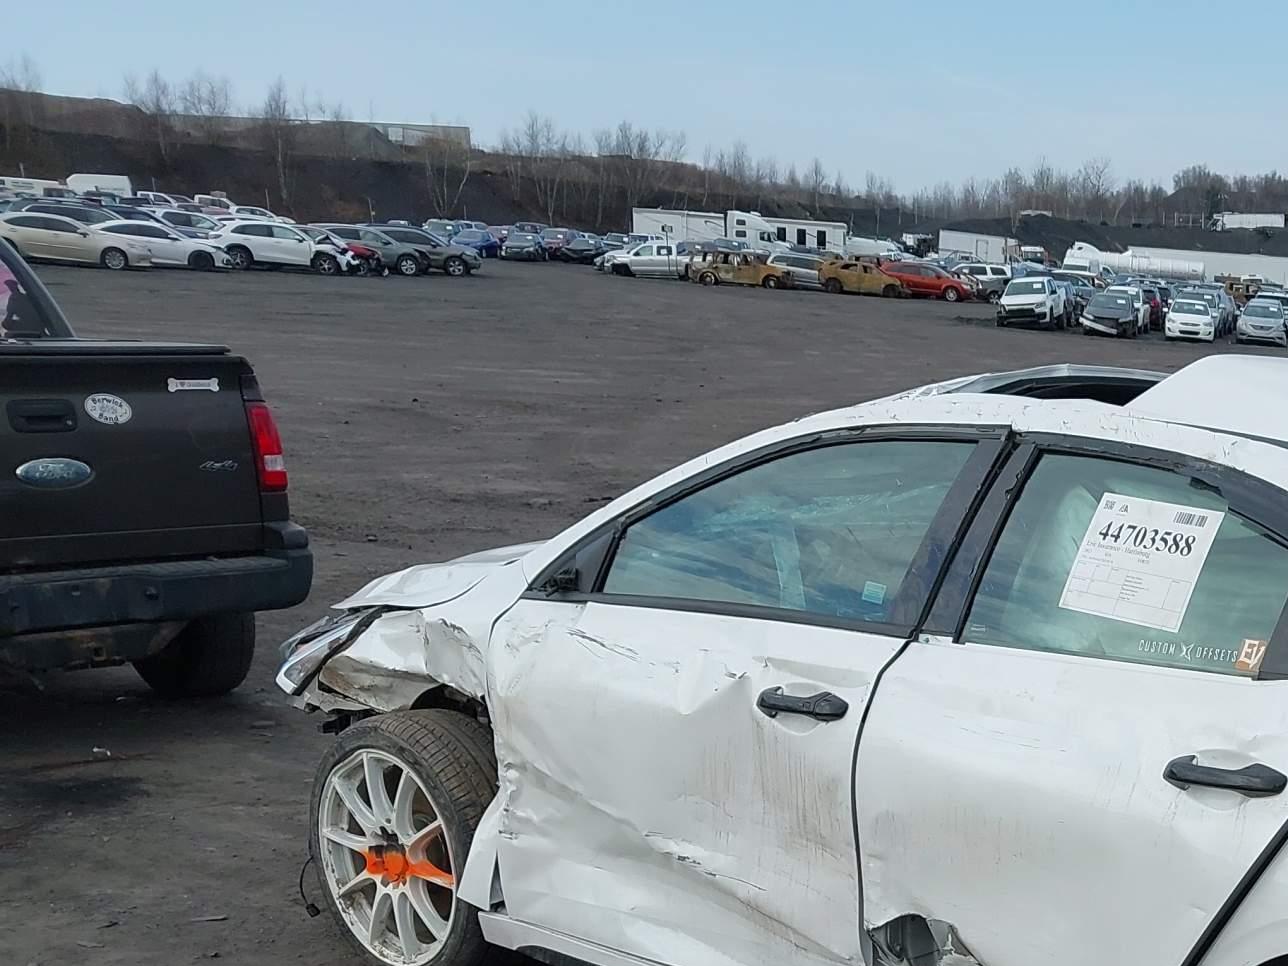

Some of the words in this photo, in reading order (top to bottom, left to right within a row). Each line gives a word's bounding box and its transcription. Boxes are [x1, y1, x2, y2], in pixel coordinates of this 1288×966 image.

[1098, 520, 1197, 558] 44703588
[1138, 639, 1176, 656] CUSTOM
[1195, 646, 1238, 662] OFFSETS
